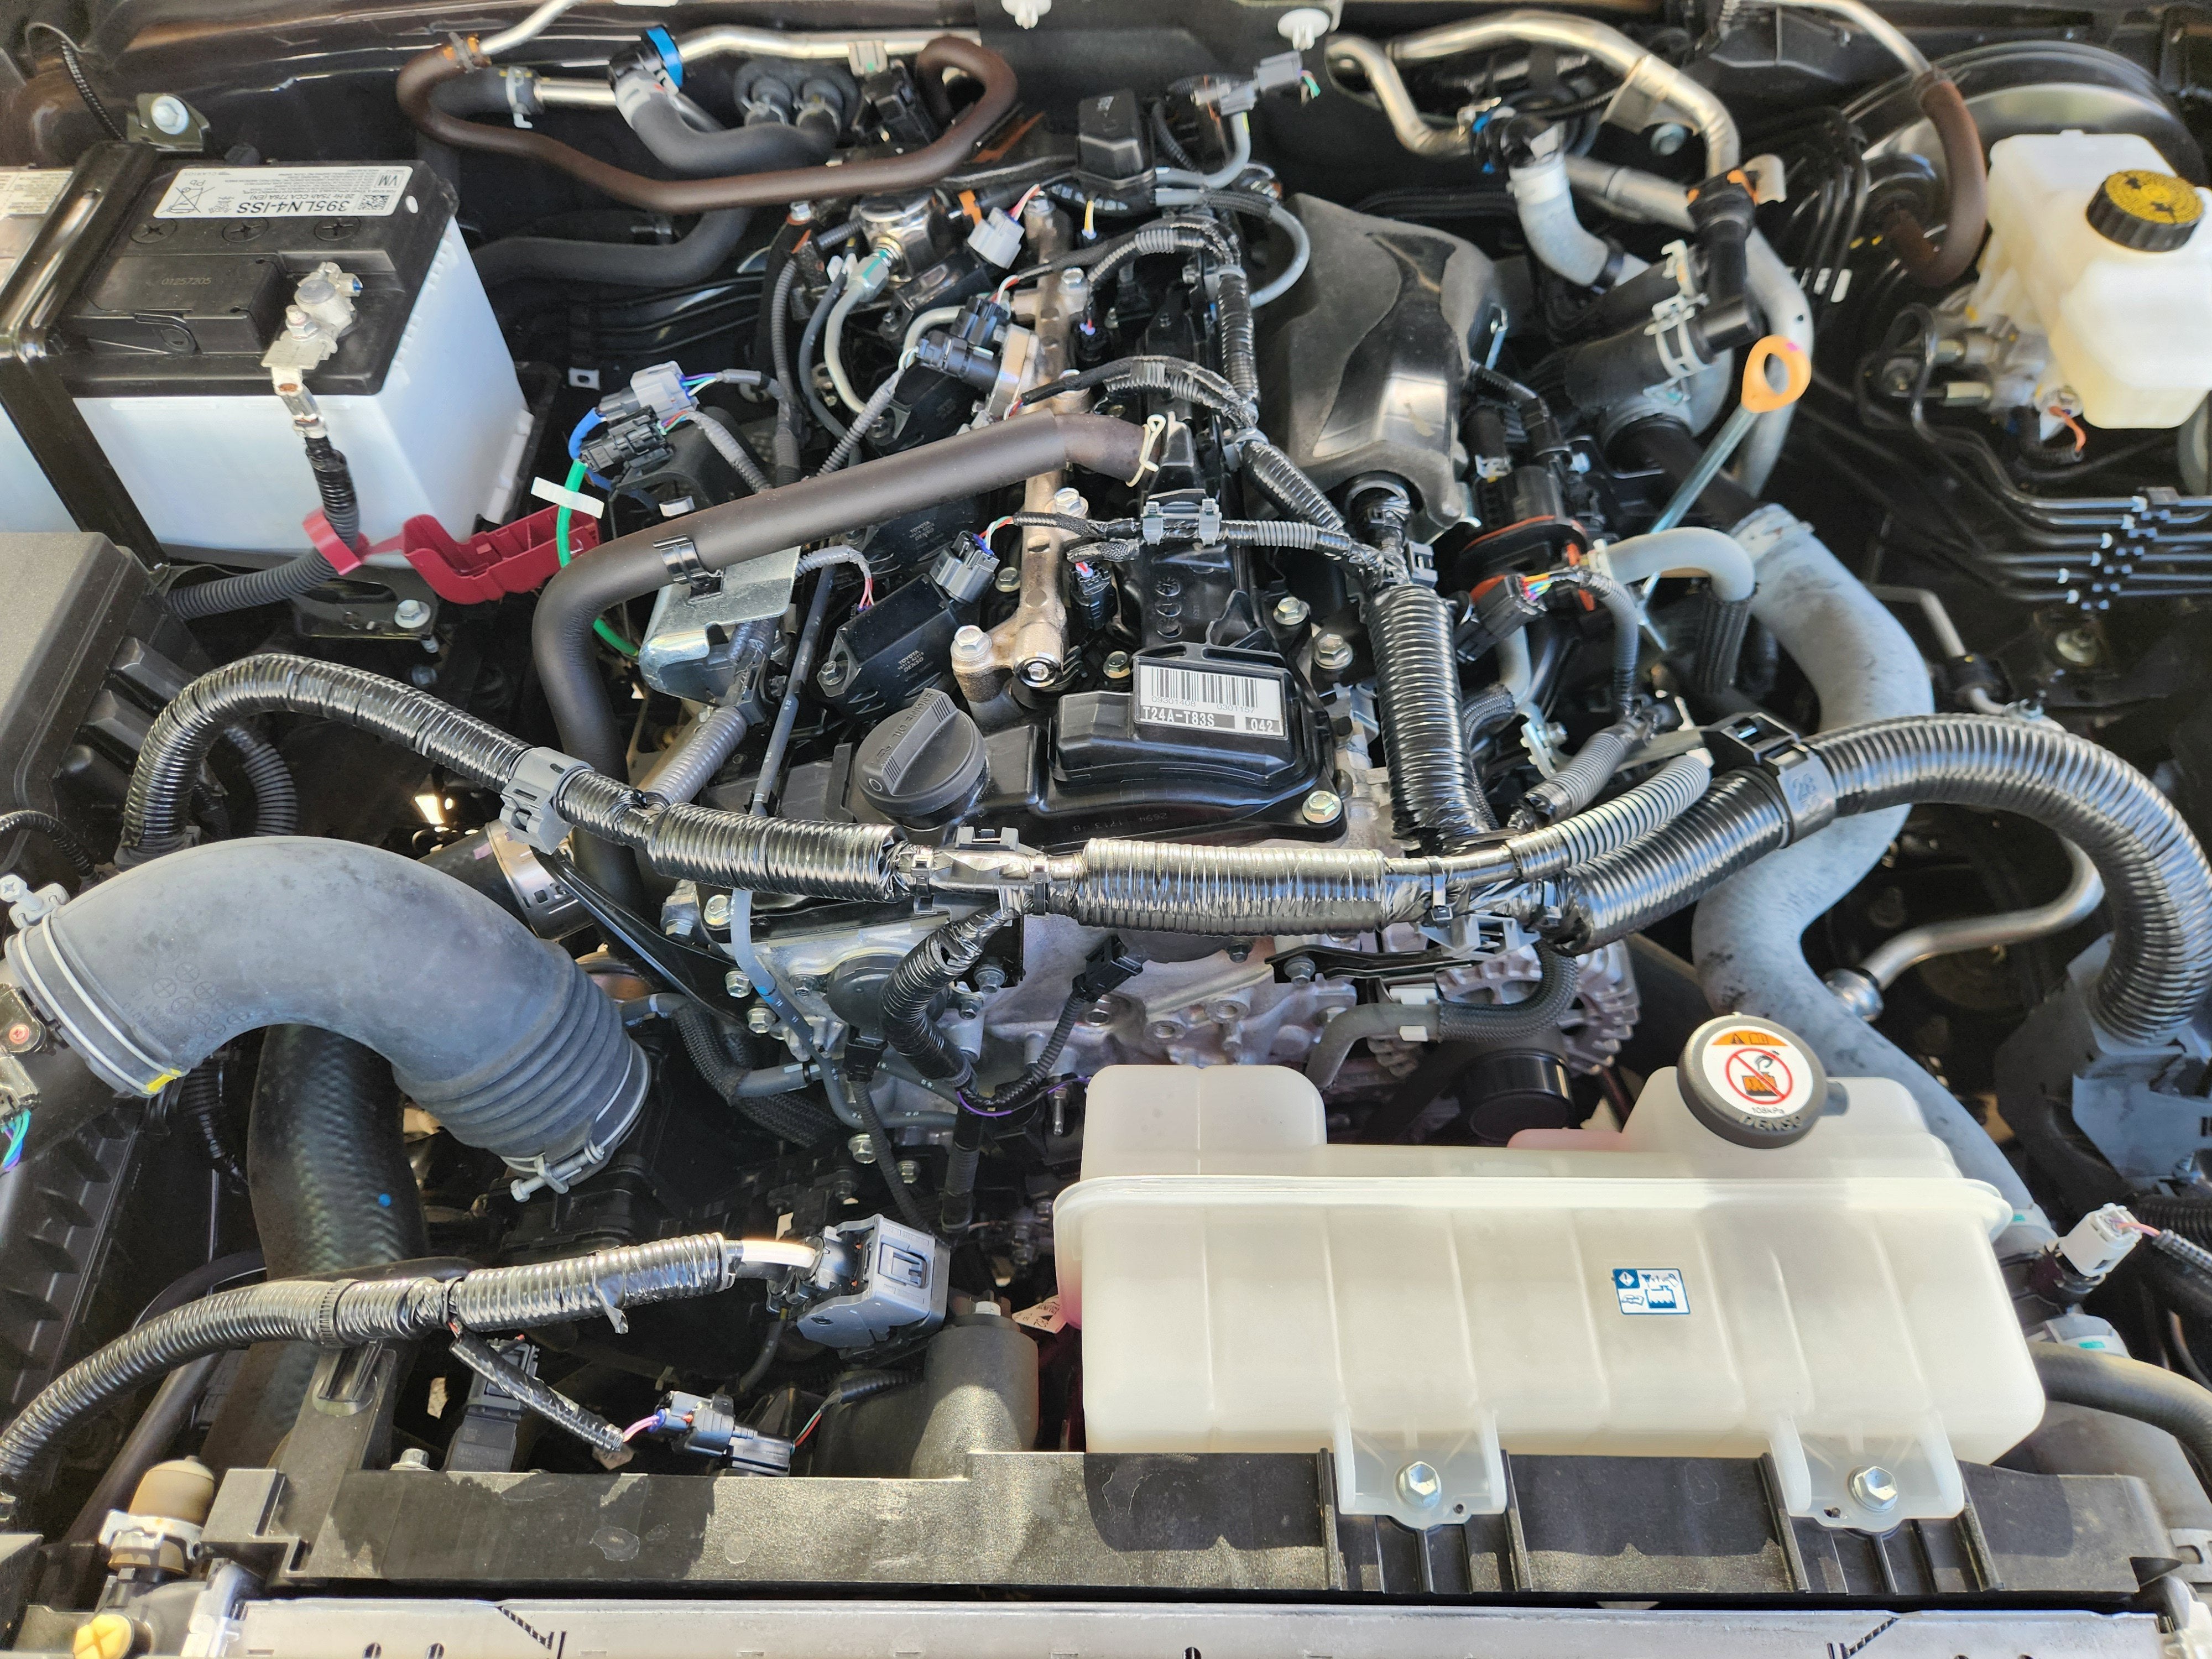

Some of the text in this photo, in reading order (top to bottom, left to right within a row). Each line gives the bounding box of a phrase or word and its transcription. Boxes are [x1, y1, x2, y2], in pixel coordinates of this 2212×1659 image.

[378, 175, 398, 186] VM
[237, 200, 351, 213] 395LN4-ISS
[898, 650, 920, 665] TOYOTA
[904, 656, 924, 672] DENSO
[905, 692, 935, 721] ENGINE
[1151, 695, 1196, 707] 09301408
[1216, 703, 1255, 714] 0301157
[1142, 706, 1274, 732] T24A-T83S 042
[892, 724, 908, 737] OIL
[1738, 1114, 1802, 1132] DENSO
